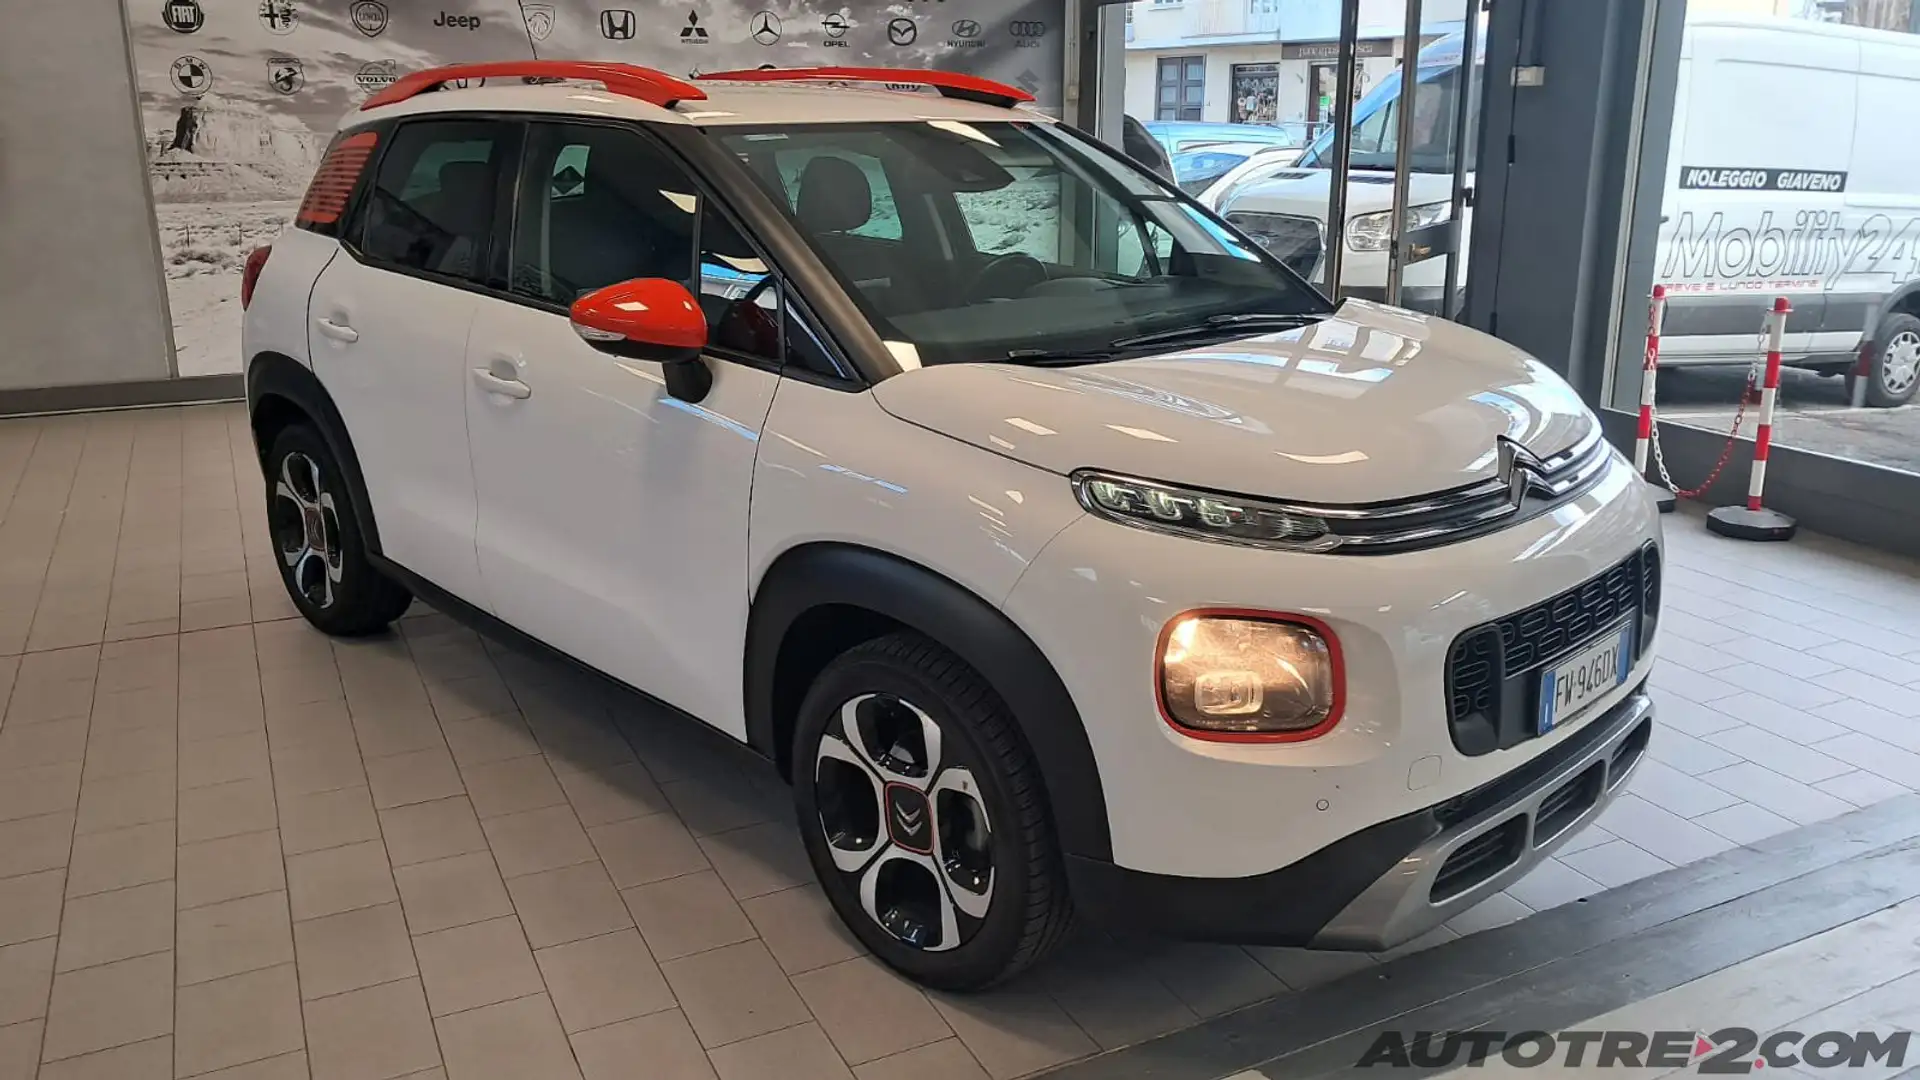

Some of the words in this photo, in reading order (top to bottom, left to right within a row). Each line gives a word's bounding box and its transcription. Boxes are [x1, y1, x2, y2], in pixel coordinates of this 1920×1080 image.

[171, 5, 196, 23] FIAT
[433, 11, 481, 30] Jeep
[1686, 169, 1767, 188] NOLEGGIO
[1777, 172, 1841, 191] GIAVENO
